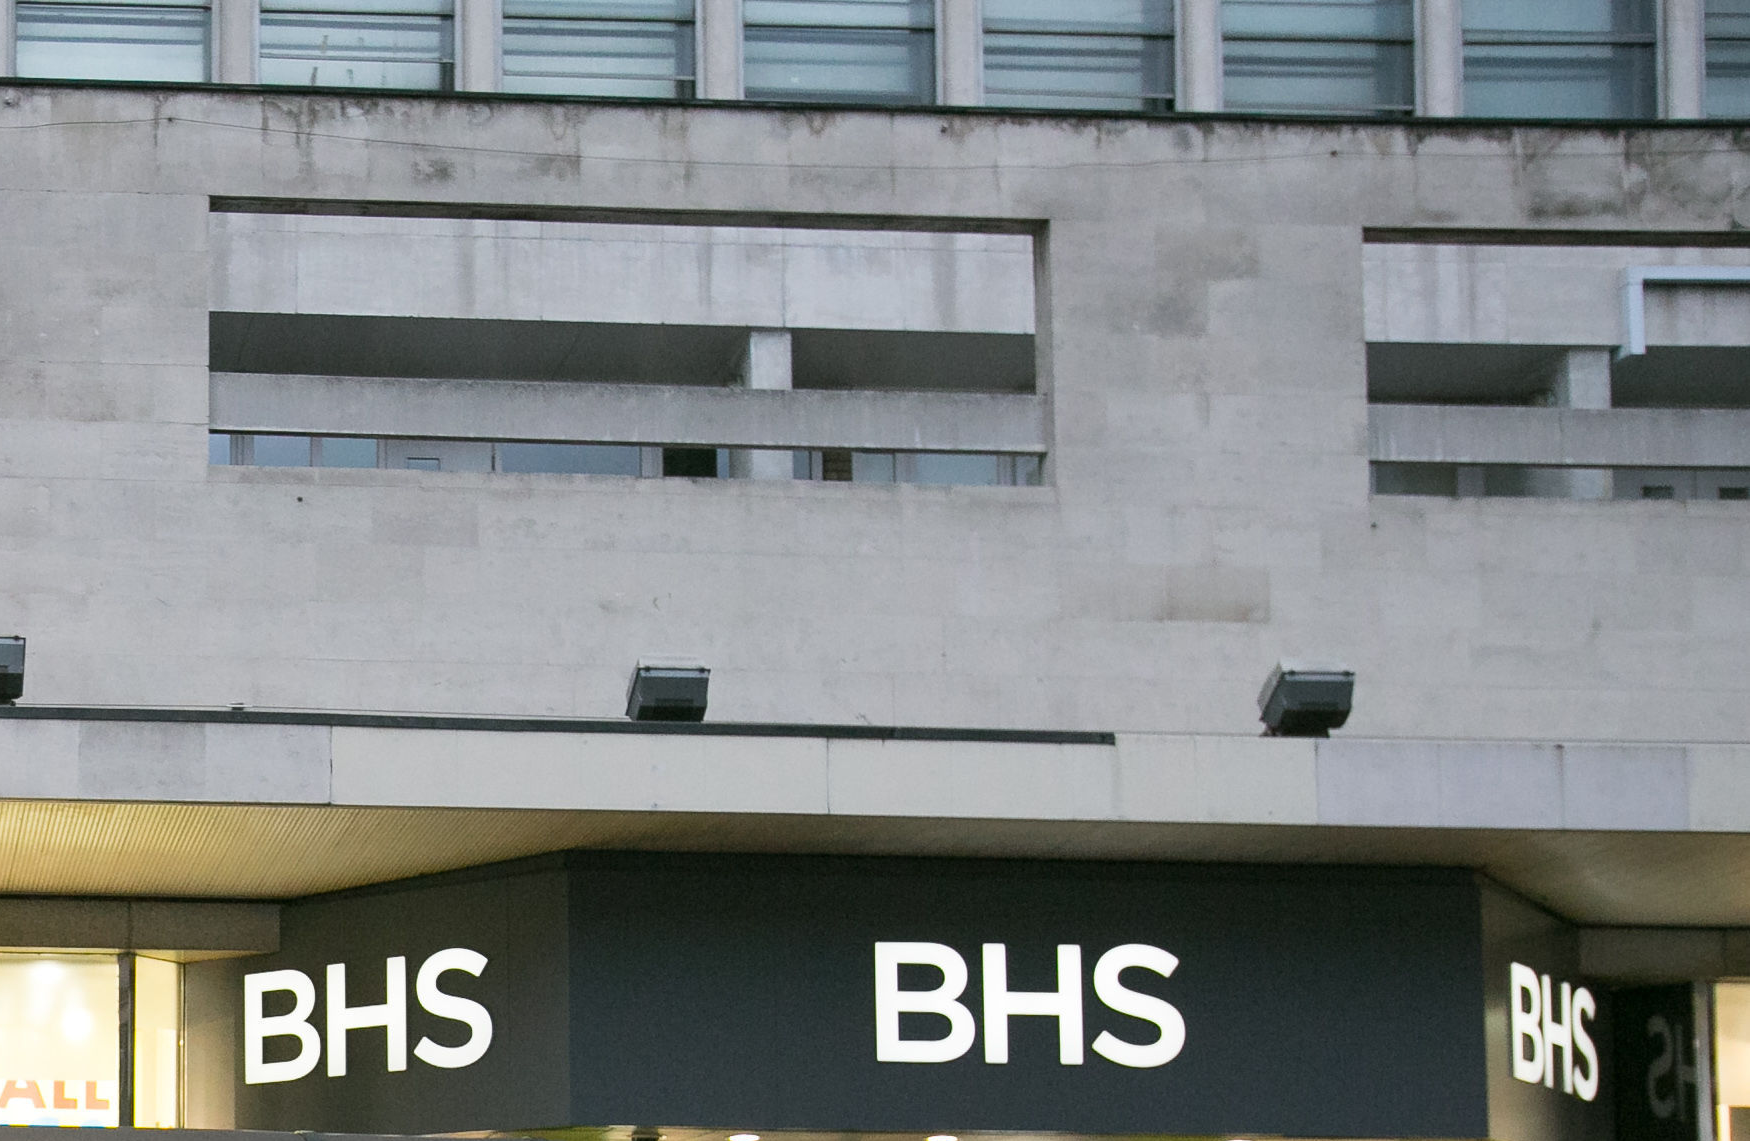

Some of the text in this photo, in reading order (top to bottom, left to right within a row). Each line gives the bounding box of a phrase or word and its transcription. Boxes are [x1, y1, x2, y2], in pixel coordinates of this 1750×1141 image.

[244, 947, 493, 1085] BHS
[874, 941, 1187, 1069] BHS
[1509, 961, 1598, 1102] BHS
